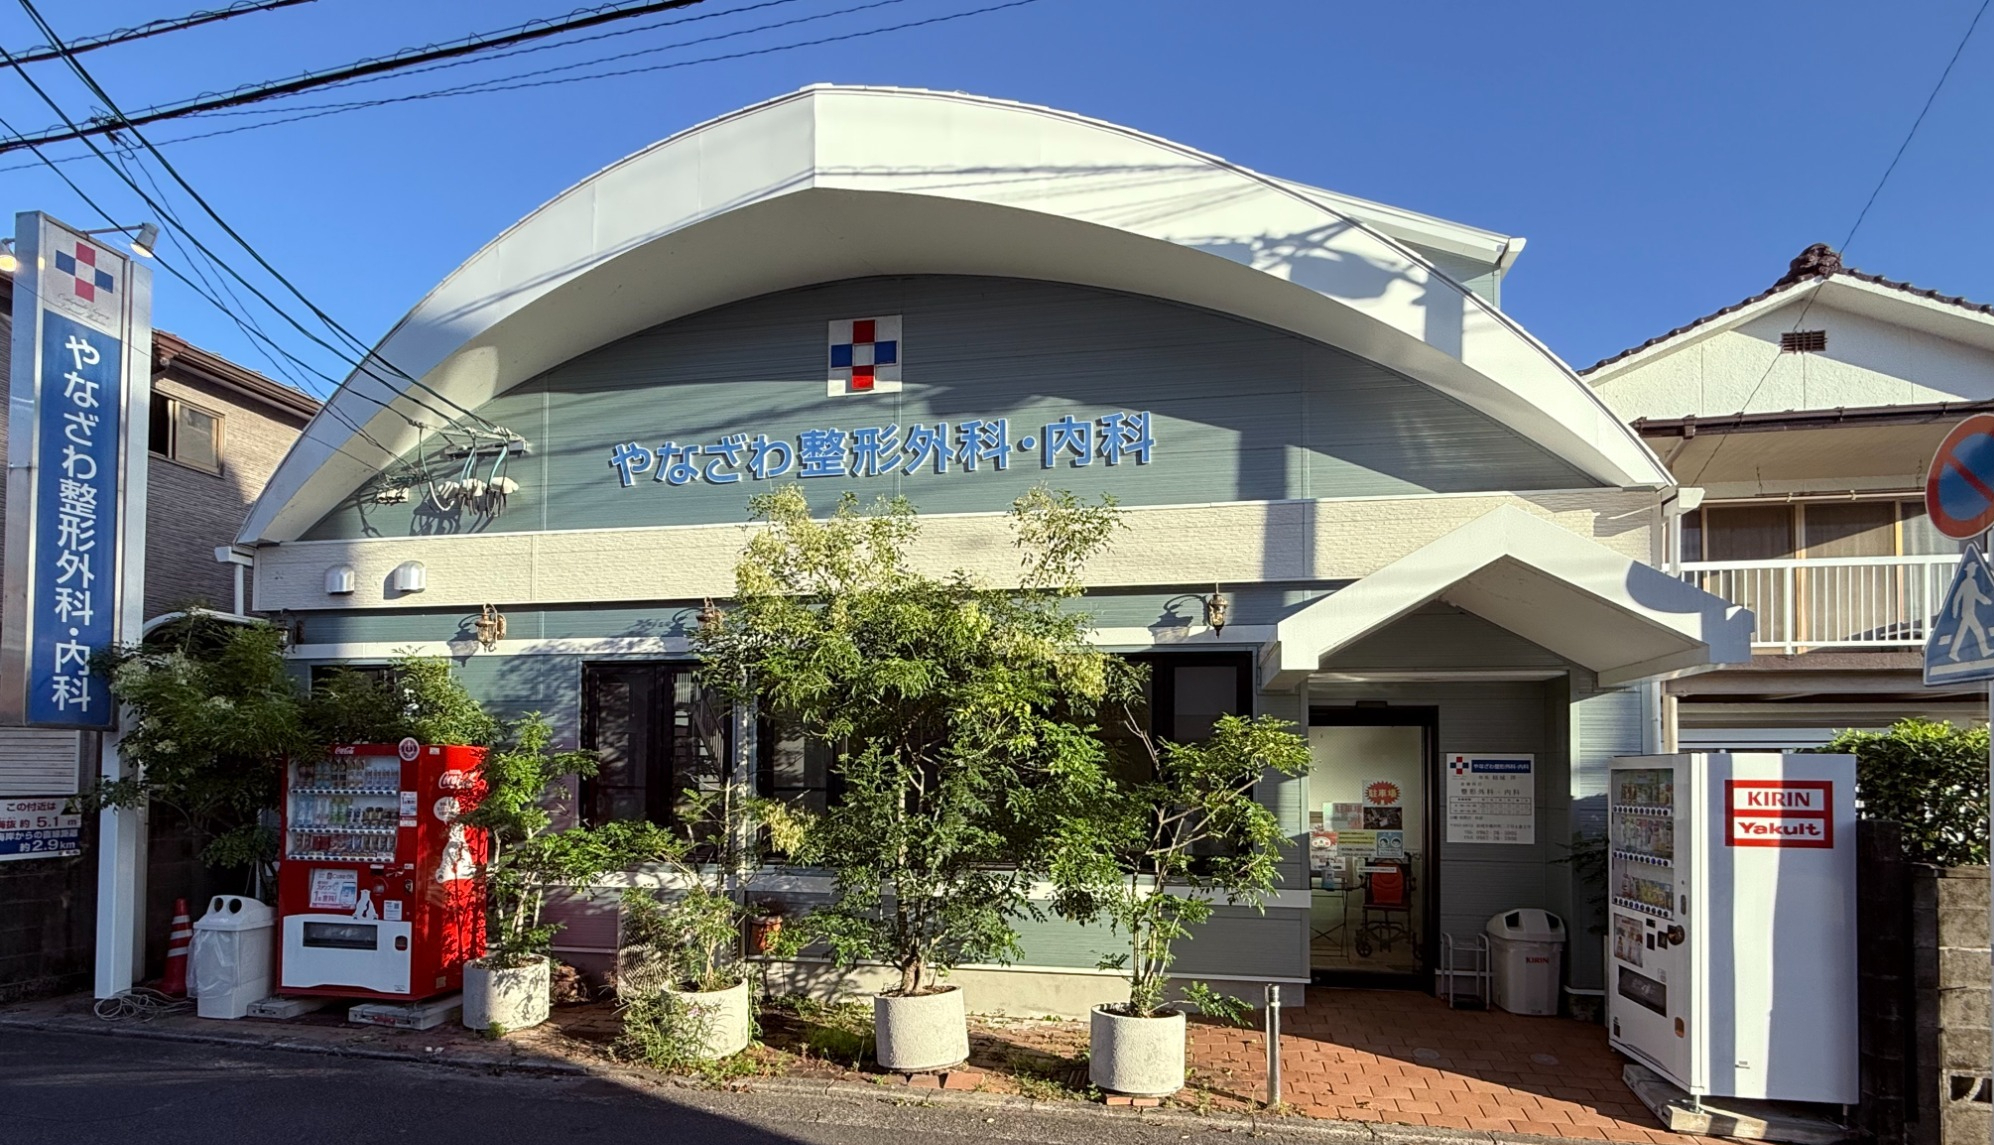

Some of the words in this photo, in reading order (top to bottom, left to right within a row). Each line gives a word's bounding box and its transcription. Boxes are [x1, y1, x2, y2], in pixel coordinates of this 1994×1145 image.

[610, 410, 1156, 487] やなざわ整形外科・内科
[51, 335, 100, 713] やなざわ整形外科・内科
[1748, 791, 1810, 807] KIRIN
[7, 802, 56, 812] この付近は
[37, 816, 59, 828] 5.1
[1738, 822, 1820, 835] Yakult
